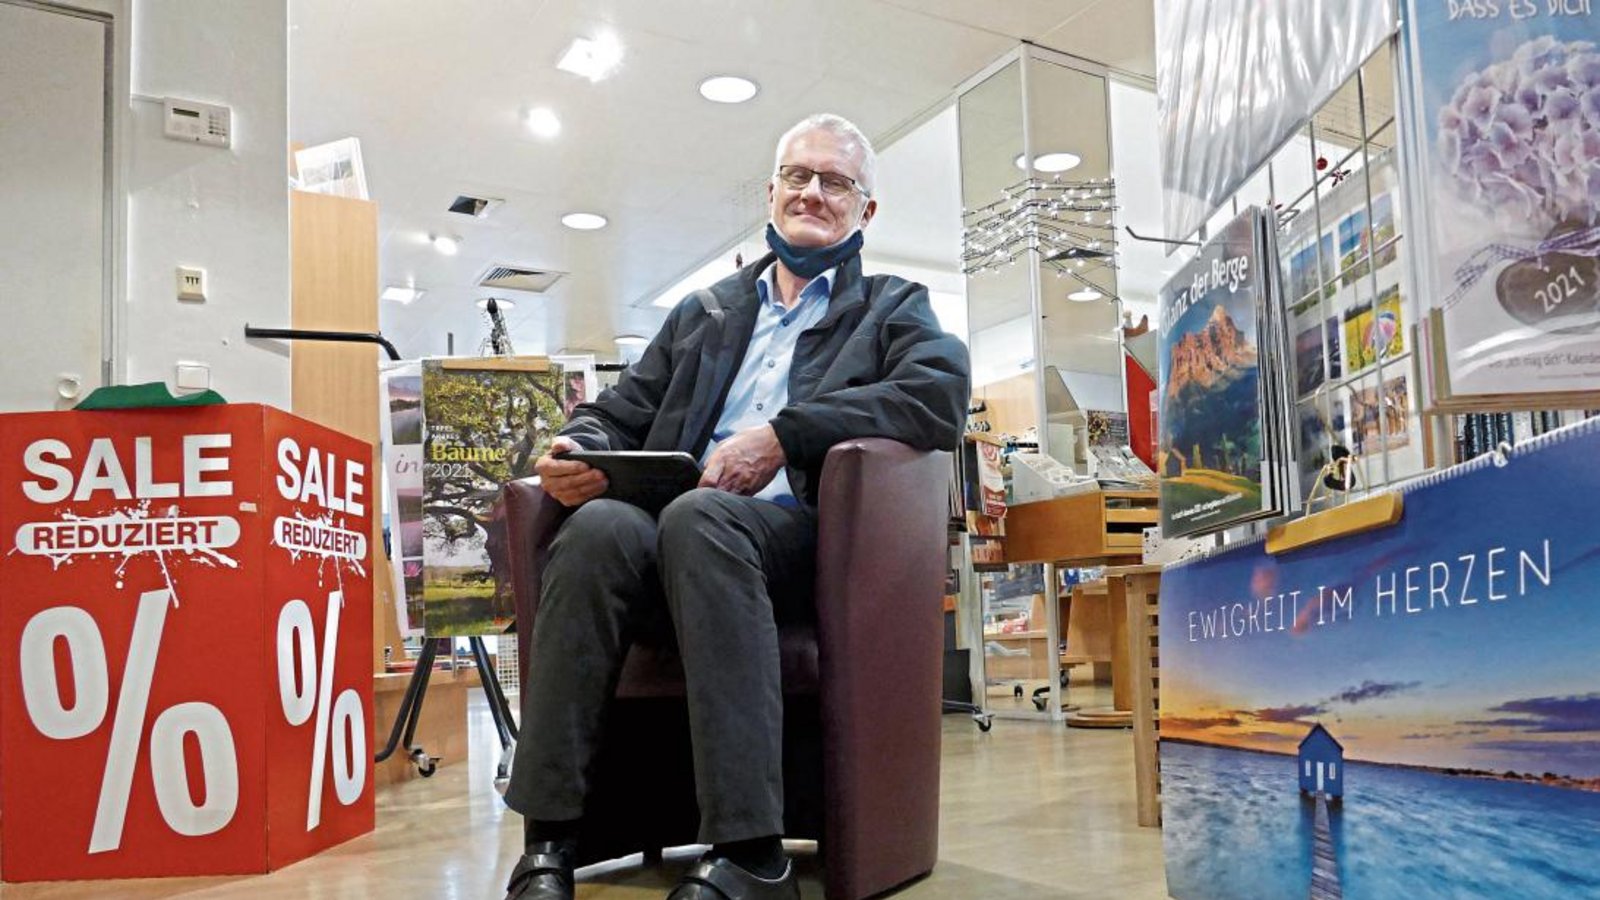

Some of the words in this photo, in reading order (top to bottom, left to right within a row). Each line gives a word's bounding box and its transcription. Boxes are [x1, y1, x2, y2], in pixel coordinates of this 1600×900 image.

[1447, 0, 1500, 20] DASS
[1509, 0, 1537, 19] ES
[1190, 272, 1209, 305] der
[1211, 255, 1248, 293] Berge
[1534, 266, 1585, 313] 2021
[22, 433, 233, 504] SALE
[276, 437, 365, 517] SALE
[33, 520, 219, 549] REDUZIERT
[281, 520, 359, 555] REDUZIERT
[1188, 591, 1302, 642] EWIGKEIT
[1316, 585, 1353, 626] IM
[1376, 538, 1552, 617] HERZEN
[20, 588, 239, 854] %
[277, 590, 366, 832] %
